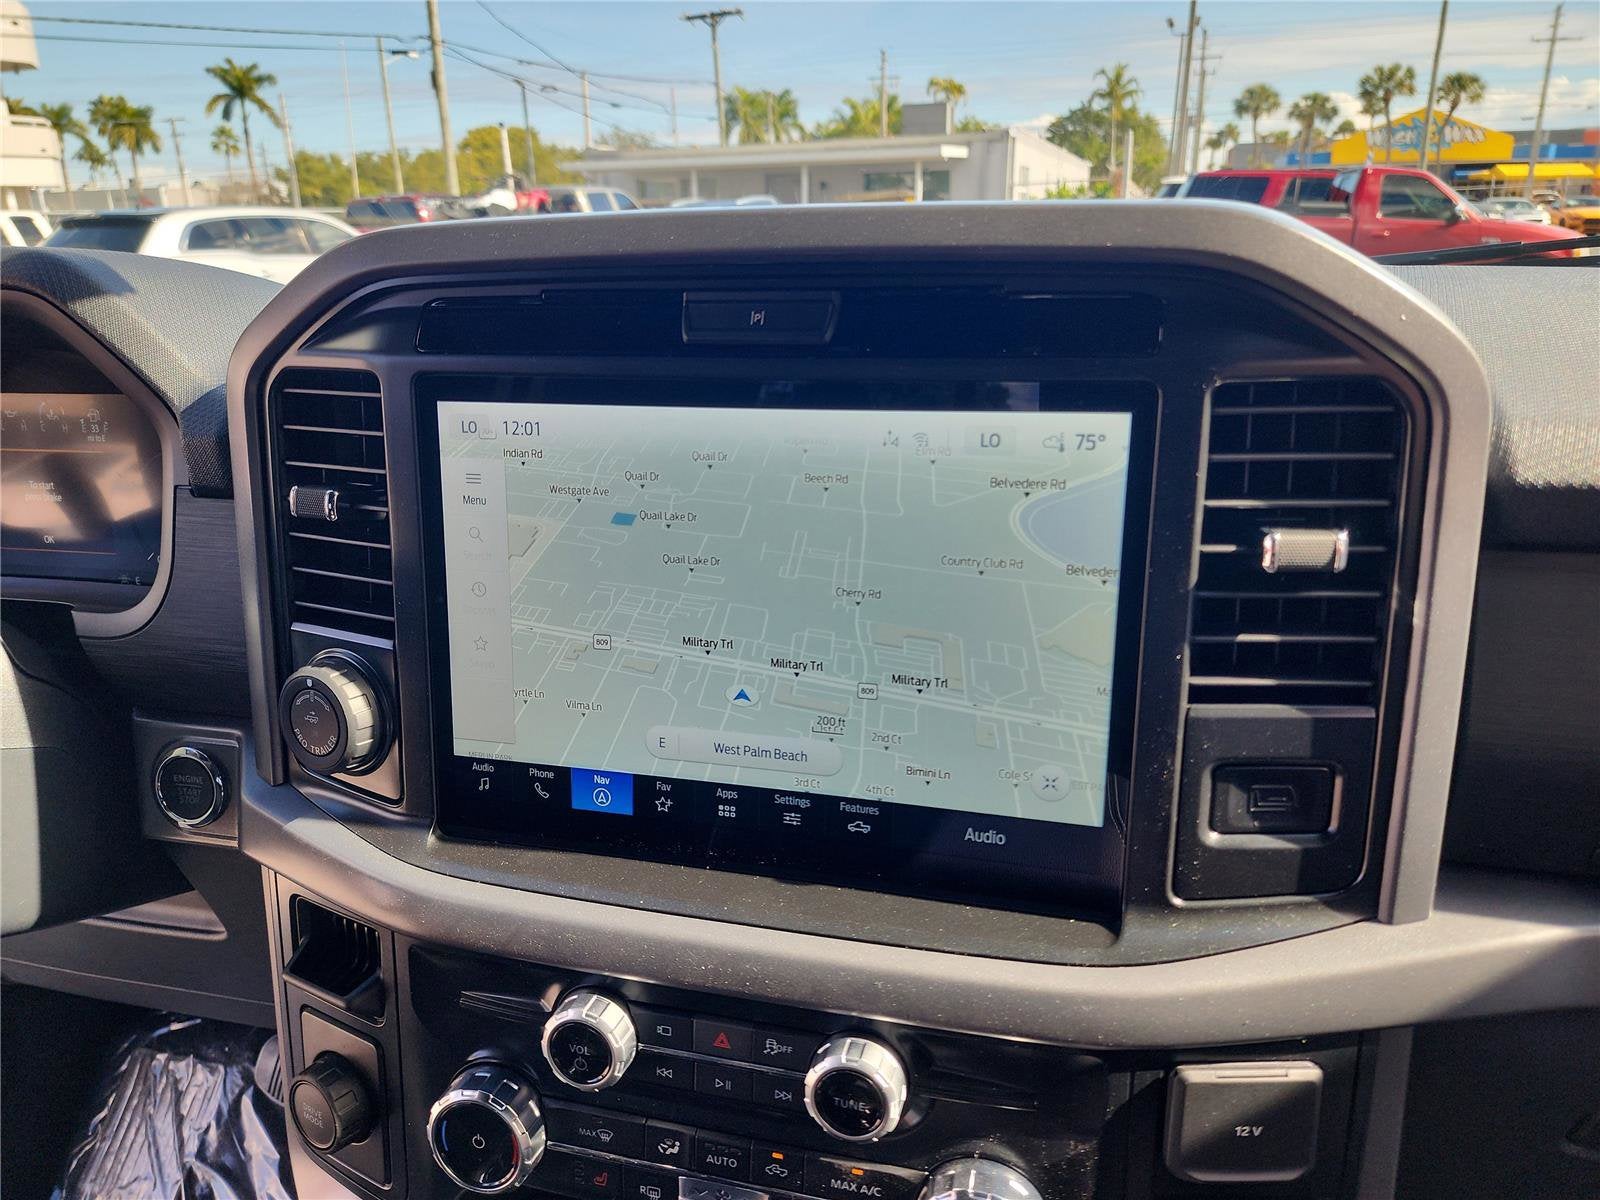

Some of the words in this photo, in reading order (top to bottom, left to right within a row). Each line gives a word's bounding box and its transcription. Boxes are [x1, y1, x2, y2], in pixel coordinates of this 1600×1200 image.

[461, 420, 478, 434] LO
[502, 420, 541, 436] 12:01
[980, 432, 1001, 448] LO
[1074, 434, 1106, 451] 75°
[503, 448, 530, 458] Indian
[531, 449, 543, 459] Rd
[692, 450, 714, 462] Quail
[716, 452, 728, 462] Dr
[624, 471, 646, 482] Quail
[648, 472, 660, 482] Dr
[804, 473, 834, 484] Beech
[835, 474, 848, 484] Rd
[990, 478, 1046, 490] Belvedere
[1050, 479, 1066, 491] Rd
[550, 484, 591, 498] Westgate
[593, 486, 610, 497] Ave
[462, 495, 487, 506] Menu
[639, 510, 662, 522] Quail
[664, 511, 686, 522] Lake
[688, 512, 697, 522] Dr
[44, 536, 55, 544] OK
[662, 554, 685, 566] Quail
[687, 555, 709, 566] Lake
[710, 556, 720, 566] Dr
[940, 556, 982, 570] Country
[984, 558, 1006, 570] Club
[1008, 558, 1023, 570] Rd
[1066, 564, 1118, 578] Belveder
[836, 587, 866, 601] Cherry
[868, 588, 881, 599] Rd
[596, 638, 609, 646] 809
[682, 636, 719, 650] Military
[720, 639, 734, 649] Trl
[770, 658, 808, 672] Military
[809, 660, 824, 672] Trl
[891, 674, 932, 688] Military
[932, 678, 948, 689] Trl
[534, 690, 545, 698] Ln
[860, 687, 874, 696] 809
[565, 699, 590, 710] Vilma
[591, 702, 602, 712] Ln
[816, 716, 836, 726] 200
[838, 718, 846, 728] ft
[294, 728, 308, 748] PRO
[310, 736, 336, 756] TRAILER
[659, 737, 666, 748] E
[872, 732, 890, 743] 2nd
[891, 734, 902, 744] Ct
[714, 742, 740, 757] West
[743, 744, 772, 758] Palm
[774, 746, 808, 762] Beach
[472, 762, 494, 773] Audio
[529, 768, 554, 779] Phone
[906, 766, 936, 778] Bimini
[939, 769, 950, 779] Ln
[594, 774, 610, 785] Nav
[999, 769, 1021, 780] Cole
[656, 782, 672, 792] Fav
[794, 776, 809, 787] 3rd
[810, 779, 821, 788] Ct
[716, 788, 738, 800] Apps
[866, 784, 882, 795] 4th
[884, 786, 895, 796] Ct
[774, 794, 810, 808] Settings
[840, 802, 880, 816] Features
[964, 827, 1006, 846] Audio
[569, 1044, 591, 1056] VOL
[776, 1044, 793, 1054] OFF
[834, 1097, 866, 1112] TUNE
[579, 1127, 597, 1138] MAX
[706, 1154, 738, 1168] AUTO
[830, 1178, 857, 1193] MAX
[860, 1183, 882, 1198] A/C
